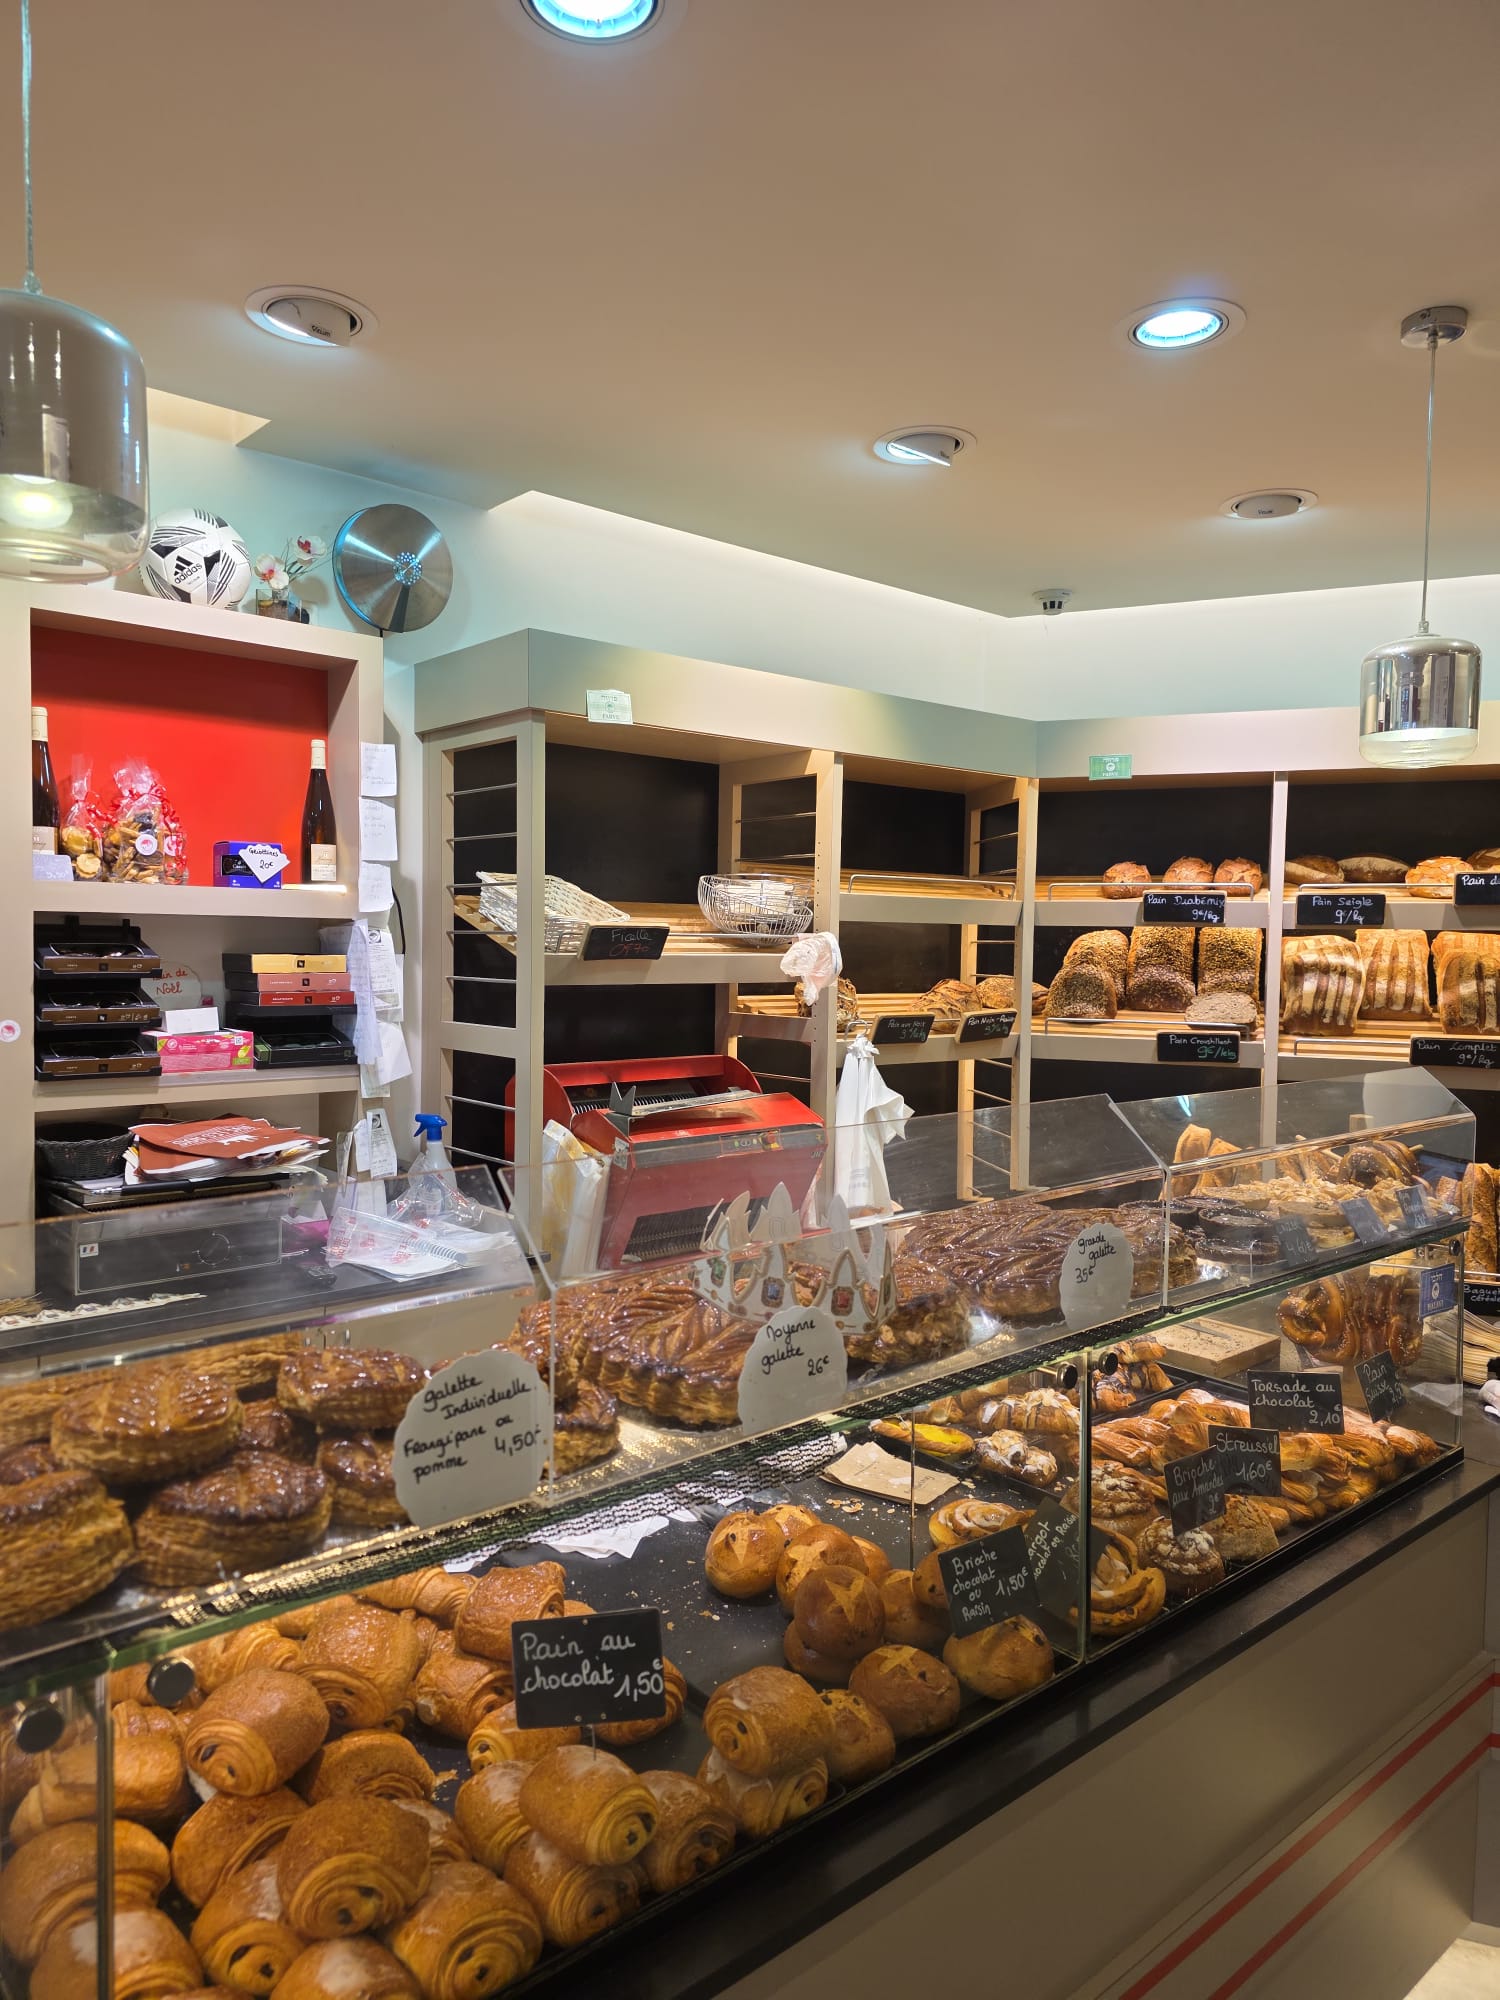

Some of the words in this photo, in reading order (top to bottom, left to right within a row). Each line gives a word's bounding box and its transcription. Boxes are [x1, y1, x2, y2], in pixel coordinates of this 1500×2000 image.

[174, 563, 203, 584] adidas
[1461, 874, 1485, 886] Pain
[1489, 875, 1500, 886] d
[1147, 894, 1167, 904] Pain
[1312, 896, 1332, 907] Pain
[1337, 896, 1374, 909] Seigle
[156, 981, 183, 995] Noël
[1169, 1034, 1188, 1045] Pain
[1416, 1040, 1441, 1050] Pain
[1449, 1042, 1497, 1054] Complet
[1089, 1242, 1117, 1268] galette
[761, 1344, 805, 1375] galette
[1315, 1383, 1336, 1392] au
[440, 1378, 531, 1420] Individuelle
[1252, 1393, 1315, 1408] chocolat
[495, 1413, 514, 1427] ou
[413, 1455, 468, 1484] pomme
[1173, 1457, 1216, 1487] Brioche
[1235, 1460, 1273, 1481] 1,60€
[1172, 1490, 1189, 1509] aux
[1027, 1520, 1051, 1560] argot
[951, 1549, 998, 1576] Brioche
[952, 1567, 997, 1596] chocolat
[995, 1566, 1029, 1597] 1,50€
[968, 1588, 982, 1602] ou
[961, 1602, 992, 1622] Raisin
[520, 1632, 584, 1662] Pain
[600, 1634, 636, 1651] au
[520, 1659, 615, 1694] chocolat
[613, 1658, 664, 1702] 1,50€
